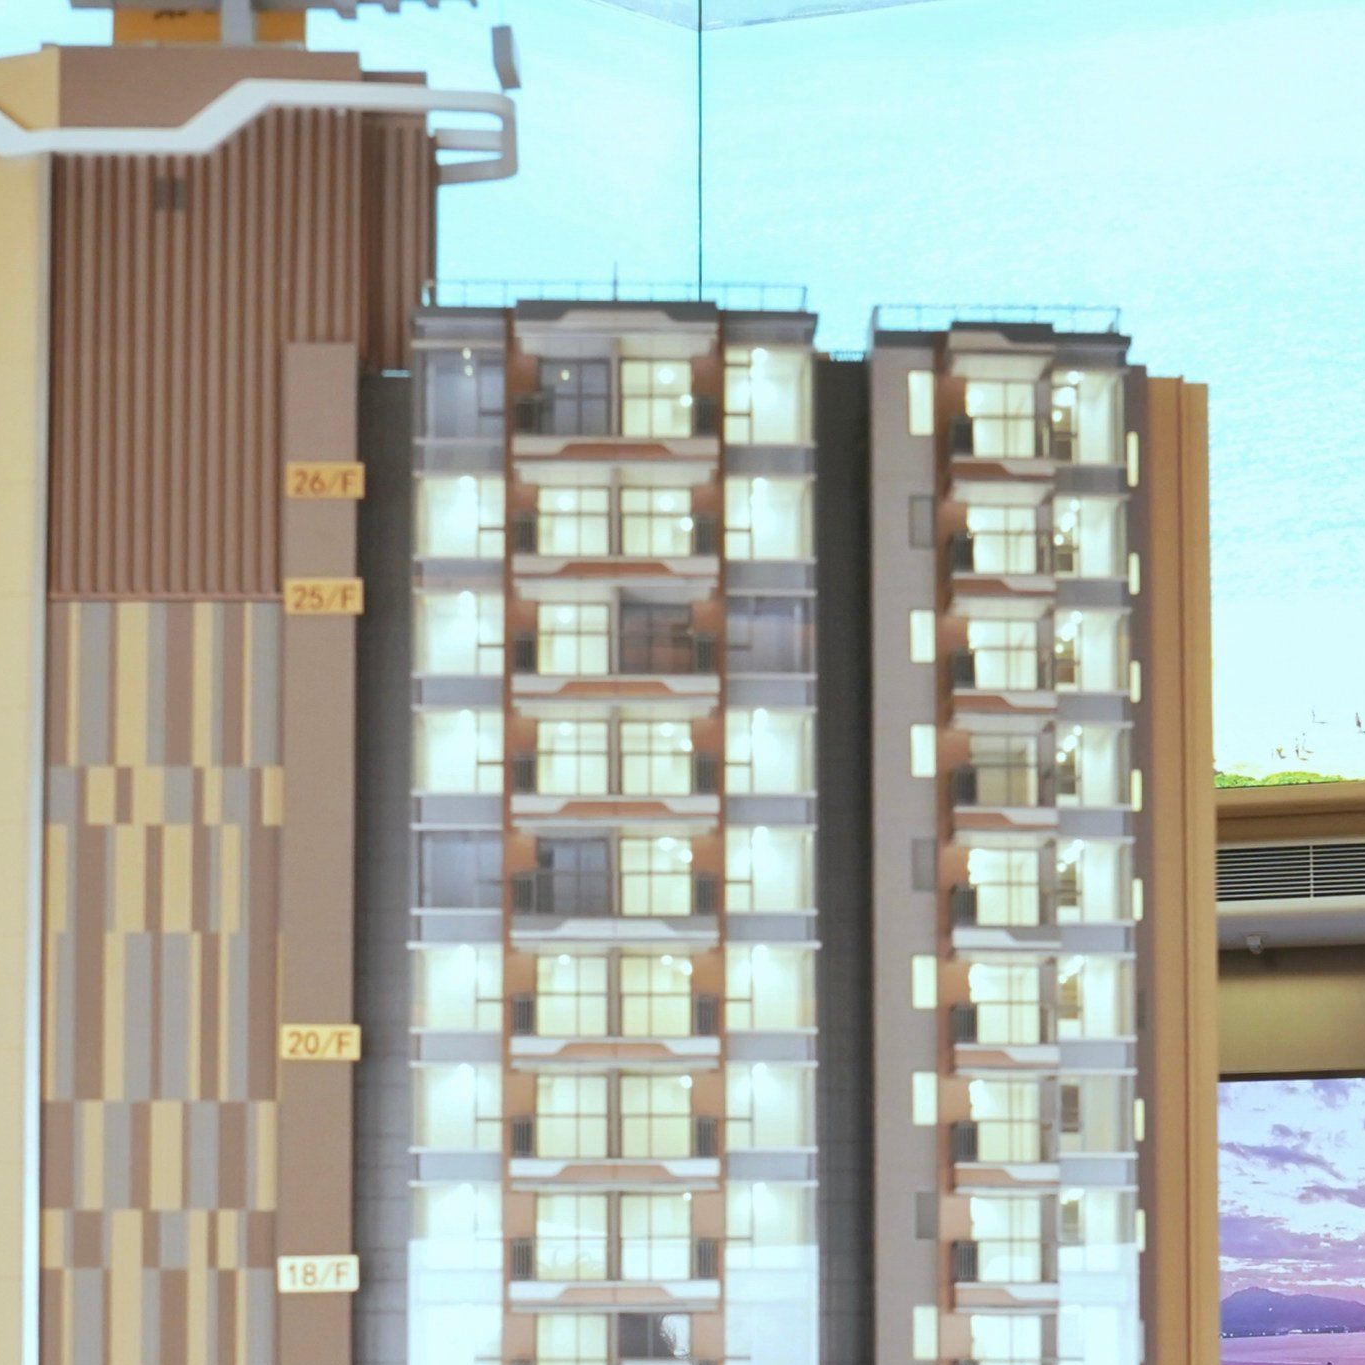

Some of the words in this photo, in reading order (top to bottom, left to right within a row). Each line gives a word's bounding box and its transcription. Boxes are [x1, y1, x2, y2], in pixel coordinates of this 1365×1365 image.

[293, 468, 356, 495] 26/F
[292, 584, 356, 611] 25/F
[287, 1031, 352, 1055] 20/F
[286, 1263, 352, 1286] 18/F
